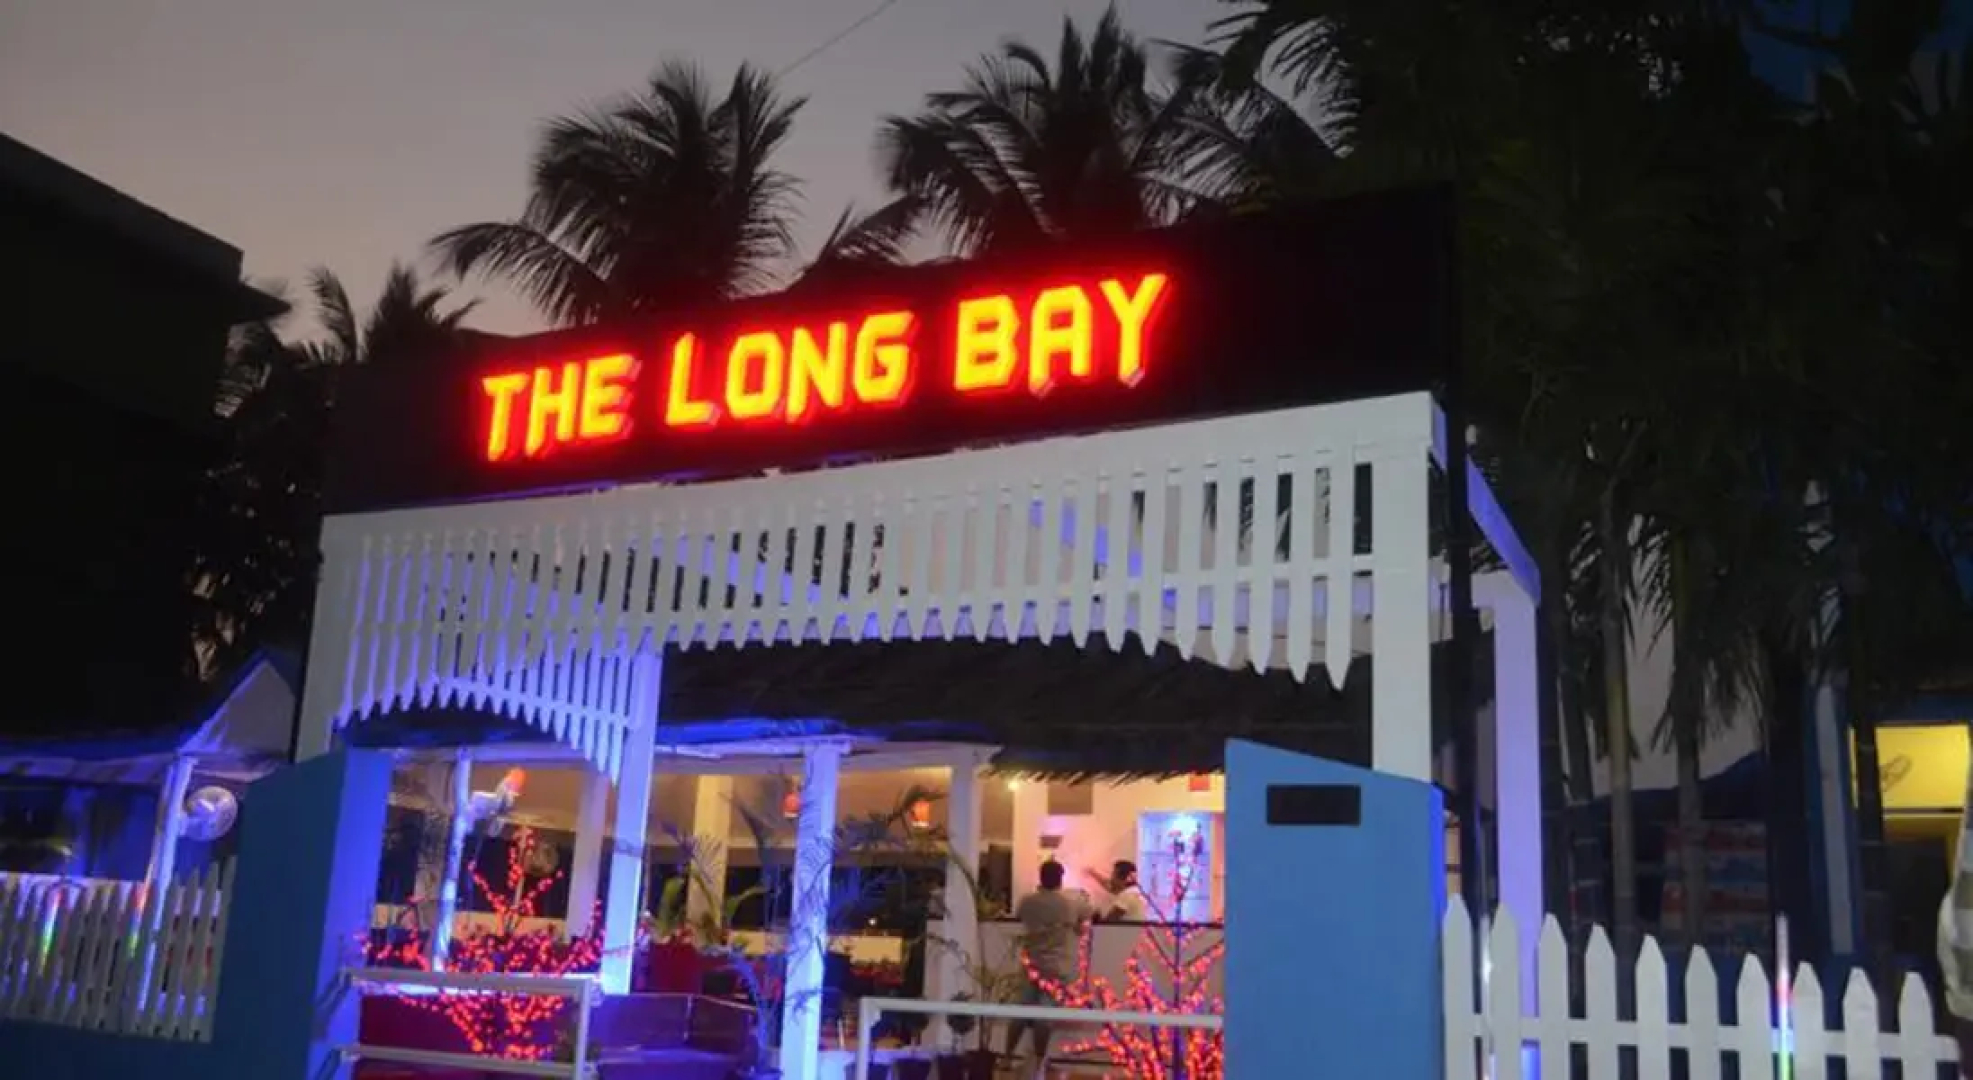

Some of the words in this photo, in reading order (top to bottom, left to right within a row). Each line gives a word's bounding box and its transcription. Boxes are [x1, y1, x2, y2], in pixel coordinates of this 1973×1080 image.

[482, 354, 637, 462] THE
[665, 311, 914, 426] LONG
[954, 273, 1169, 392] BAY
